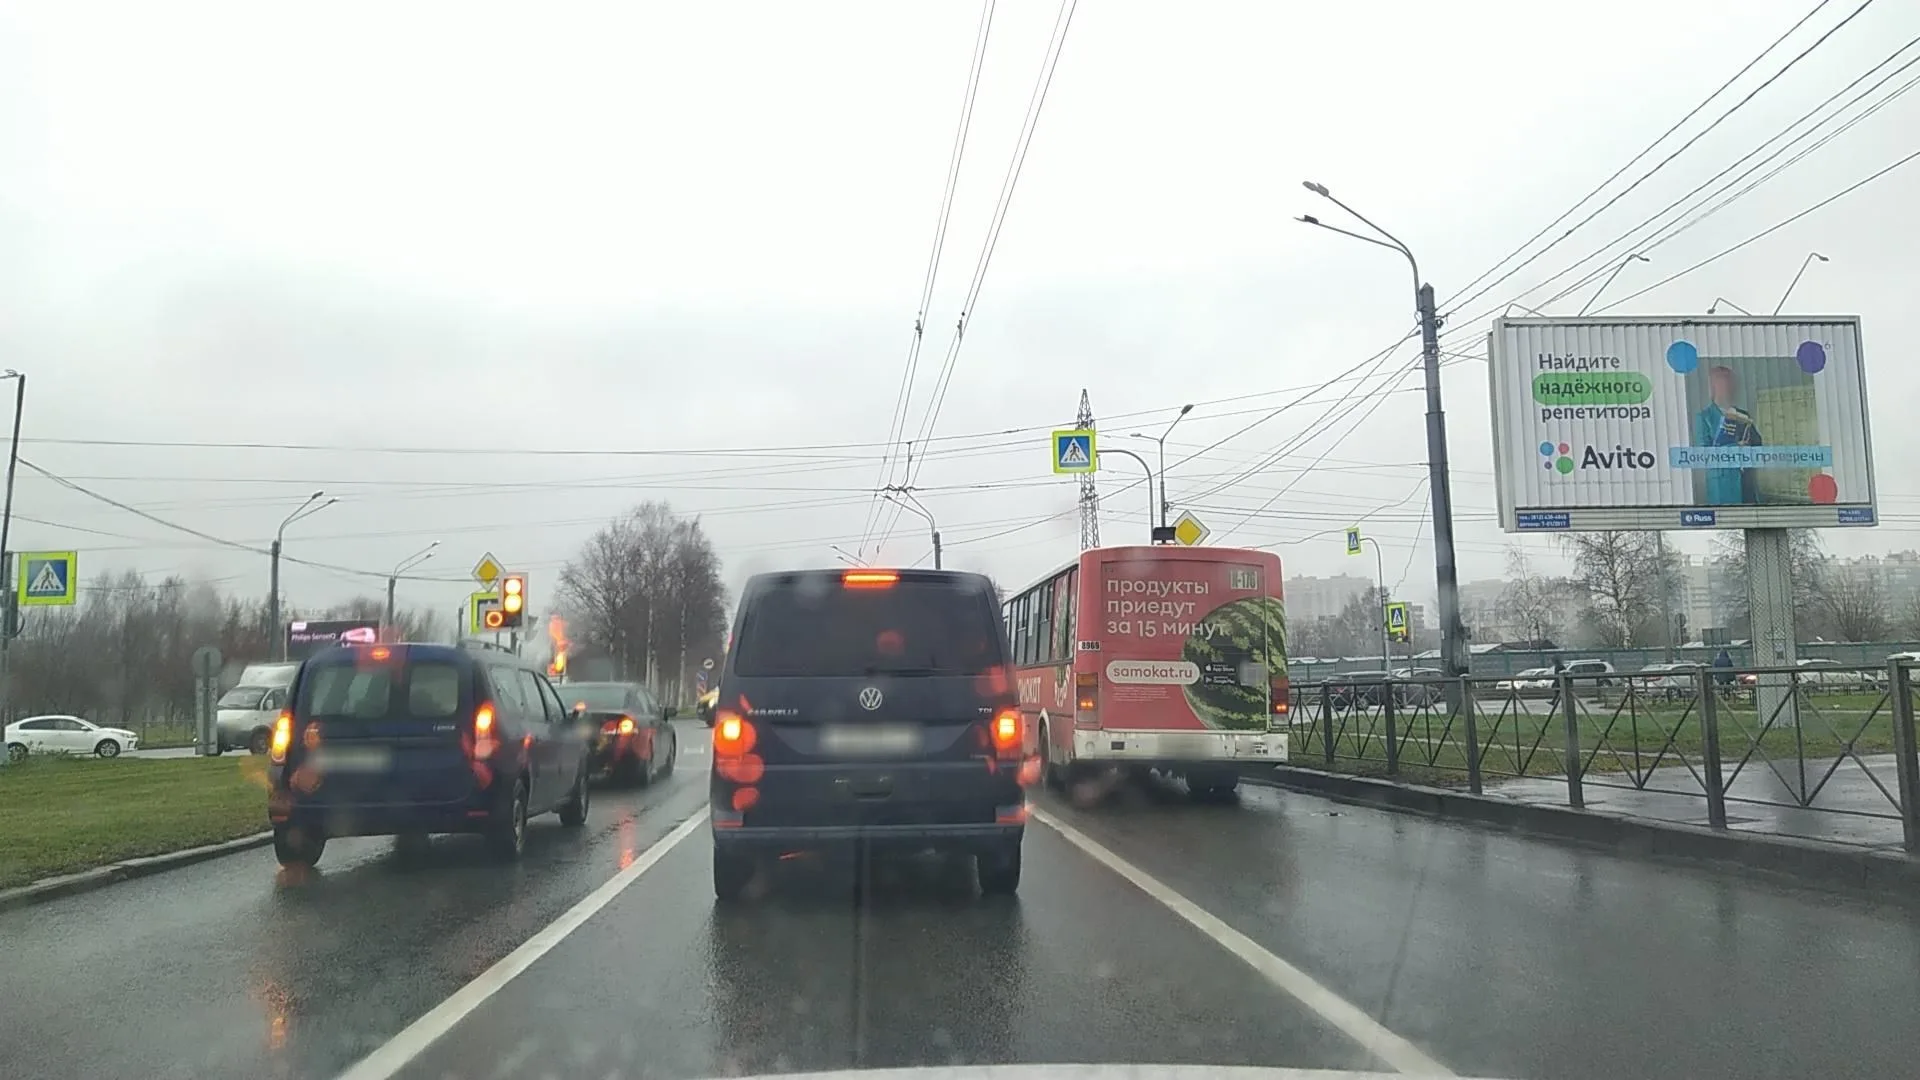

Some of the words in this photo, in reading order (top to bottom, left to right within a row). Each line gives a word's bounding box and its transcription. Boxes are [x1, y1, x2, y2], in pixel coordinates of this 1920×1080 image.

[1538, 353, 1620, 372] Найдите
[1540, 378, 1643, 398] надёжного
[1541, 405, 1651, 423] репетитора
[1581, 445, 1656, 470] Avito
[1678, 450, 1750, 466] Документы
[1693, 514, 1712, 522] Russ
[1107, 579, 1209, 598] продукты
[1107, 600, 1196, 619] приедут
[1107, 620, 1131, 634] за
[1137, 620, 1157, 637] 15
[1162, 621, 1226, 640] минут
[1113, 664, 1193, 679] samokat.ru
